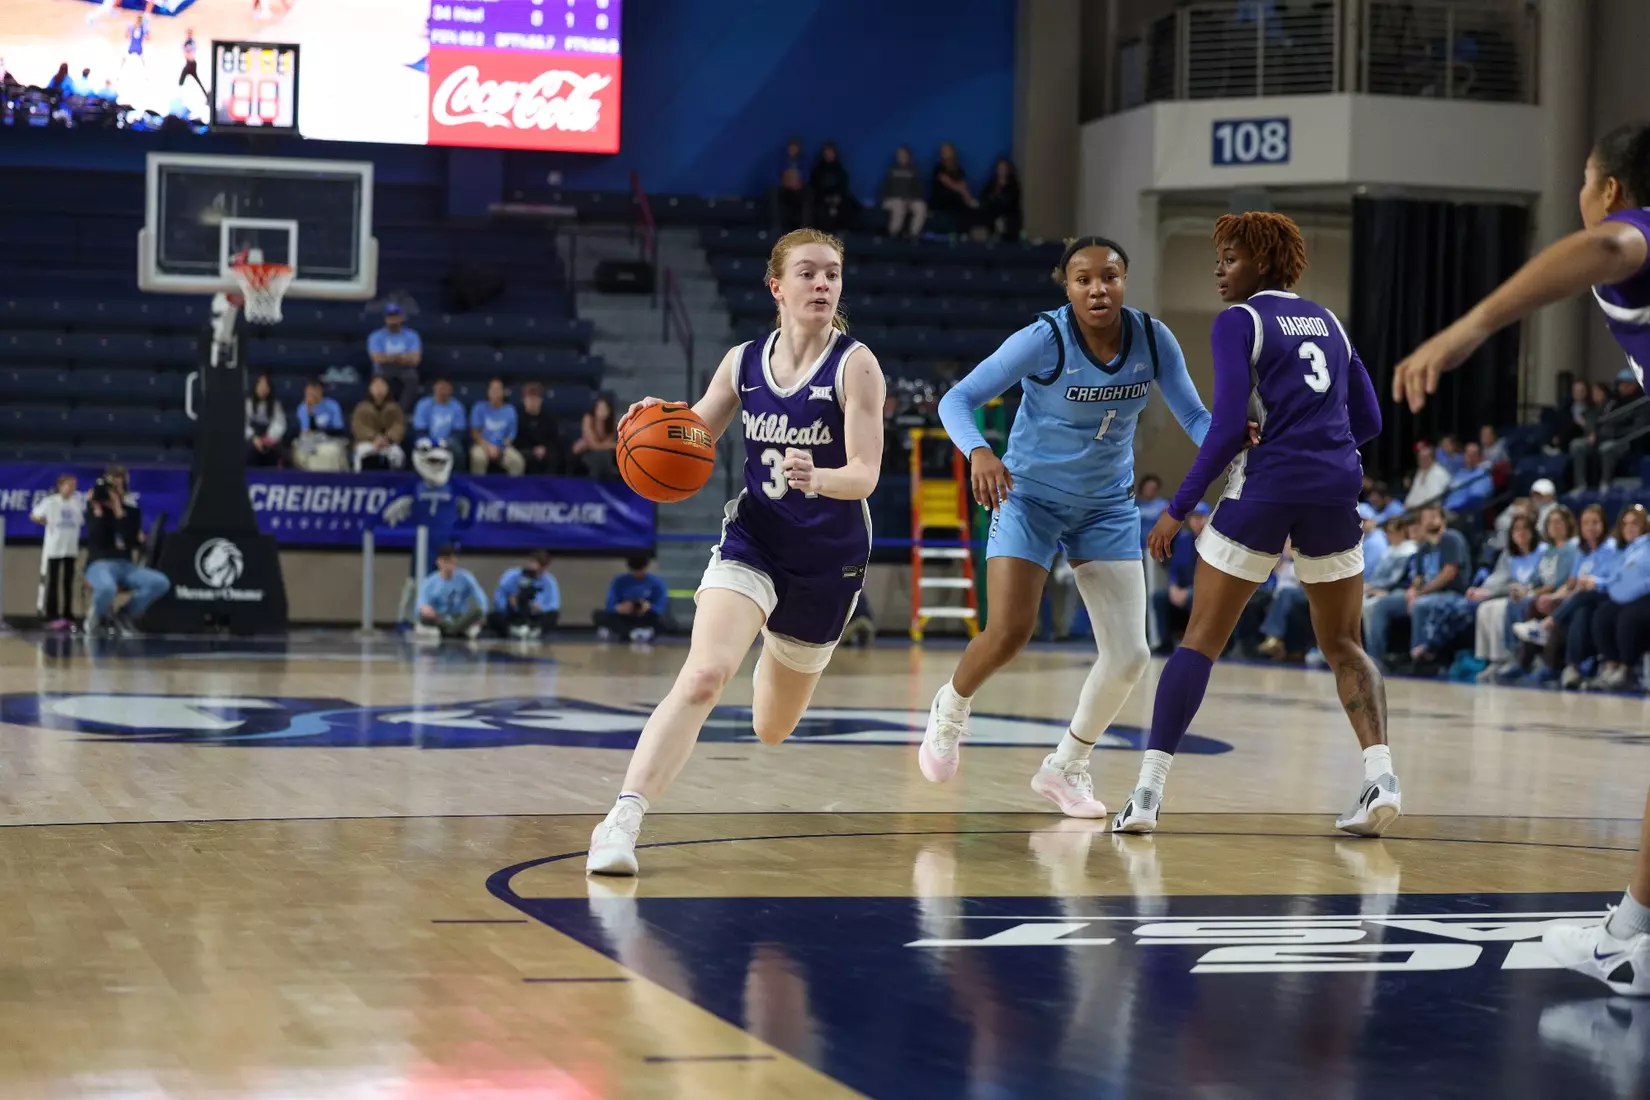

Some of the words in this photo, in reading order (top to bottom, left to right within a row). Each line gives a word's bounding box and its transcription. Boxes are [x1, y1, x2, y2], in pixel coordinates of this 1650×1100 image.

[432, 65, 612, 131] Coca-Cola
[1216, 121, 1287, 162] 108
[1276, 316, 1329, 337] HARROD
[1298, 341, 1331, 393] 3
[1066, 381, 1150, 402] CREIGHTON
[667, 425, 712, 448] ELITE
[741, 410, 833, 445] Wildcats
[1093, 409, 1118, 440] 1
[761, 447, 819, 500] 3
[0, 488, 30, 511] HE
[249, 483, 396, 514] CREIGHTO
